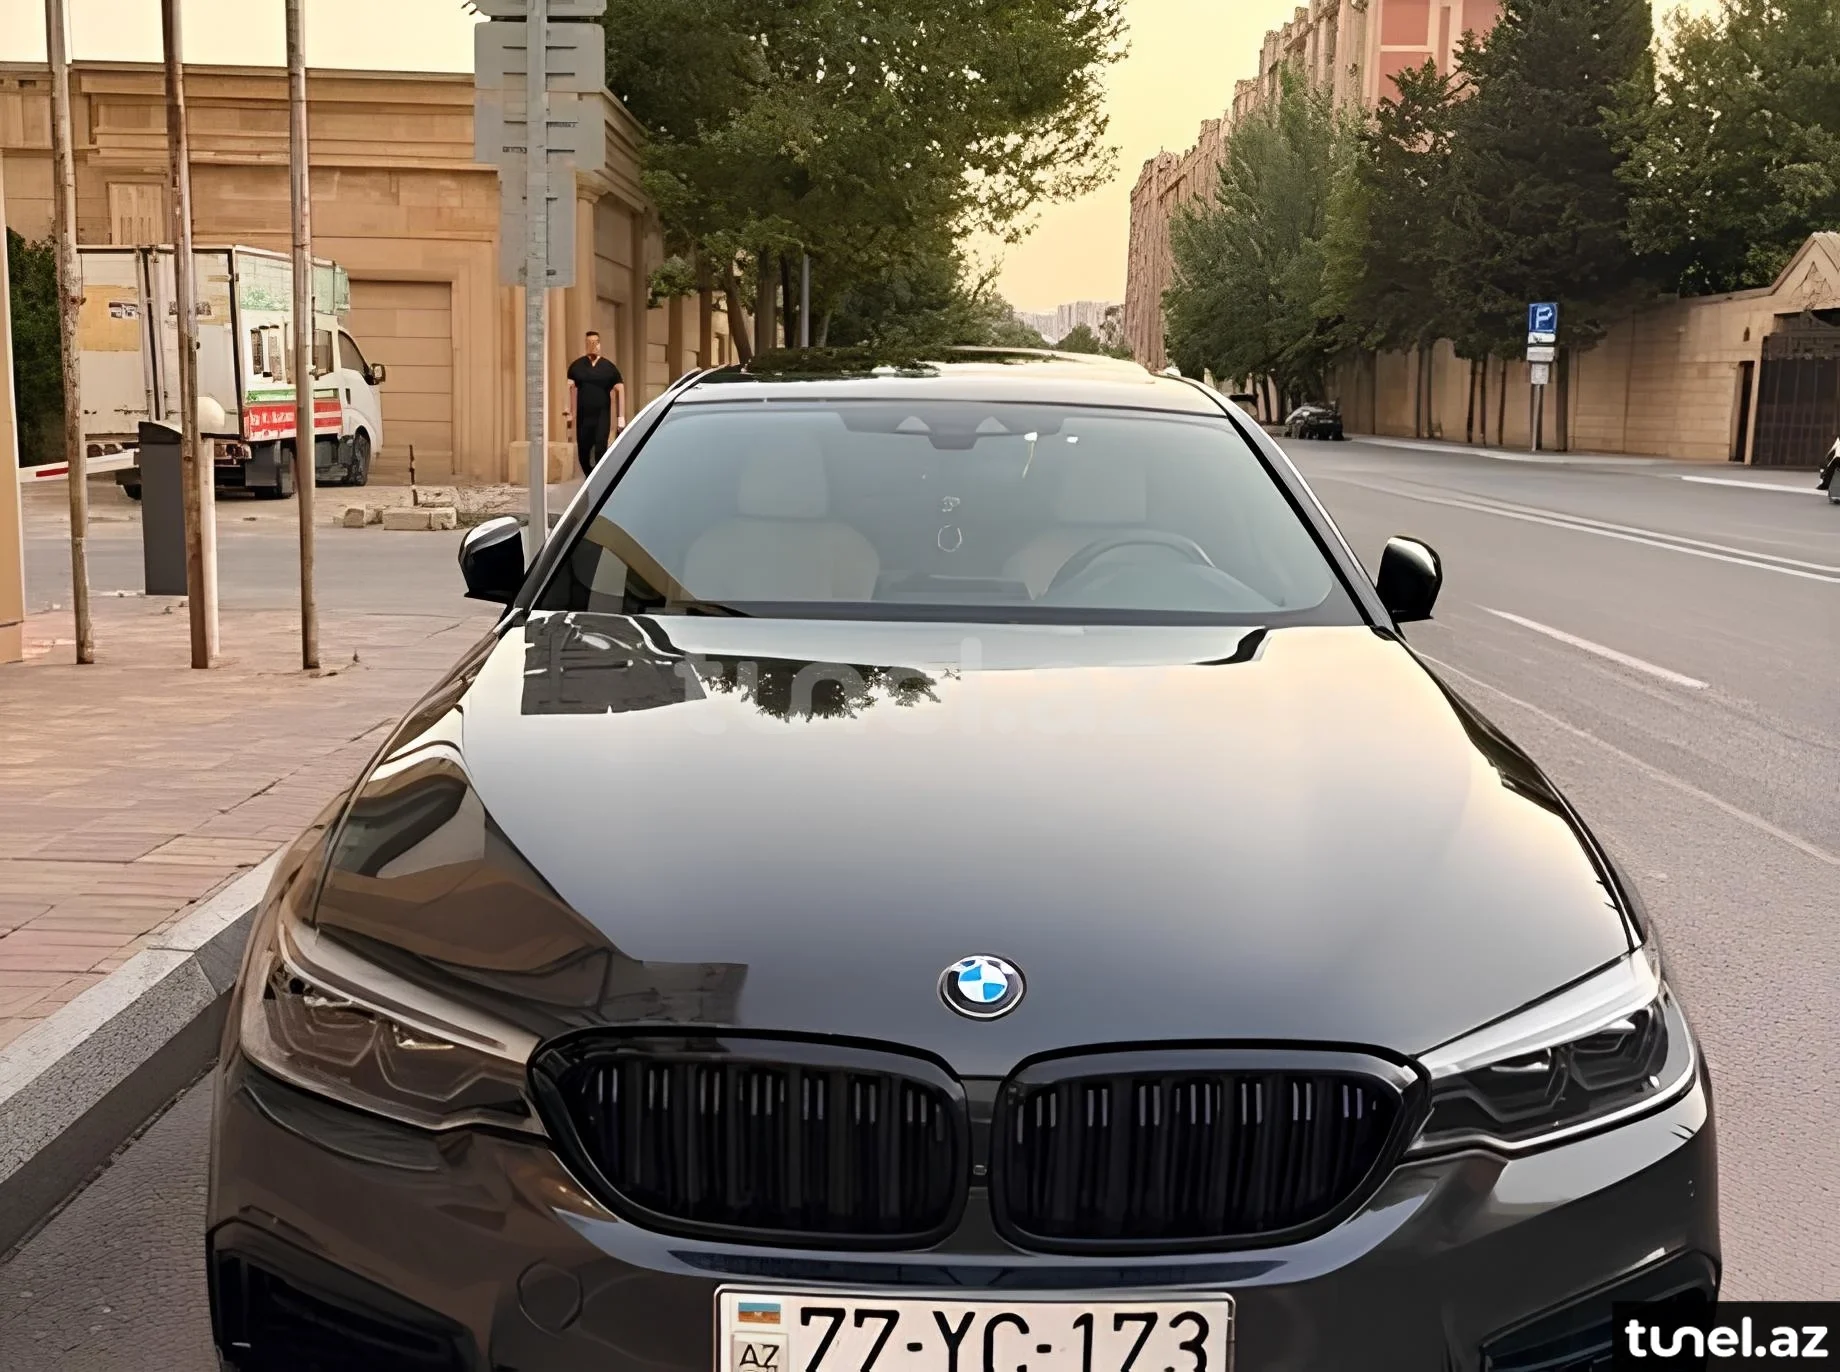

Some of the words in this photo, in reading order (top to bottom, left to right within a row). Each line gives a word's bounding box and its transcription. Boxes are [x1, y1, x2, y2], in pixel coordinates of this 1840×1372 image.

[1535, 306, 1553, 330] P
[800, 1307, 1210, 1372] 77-YC-173
[739, 1343, 780, 1368] AZ
